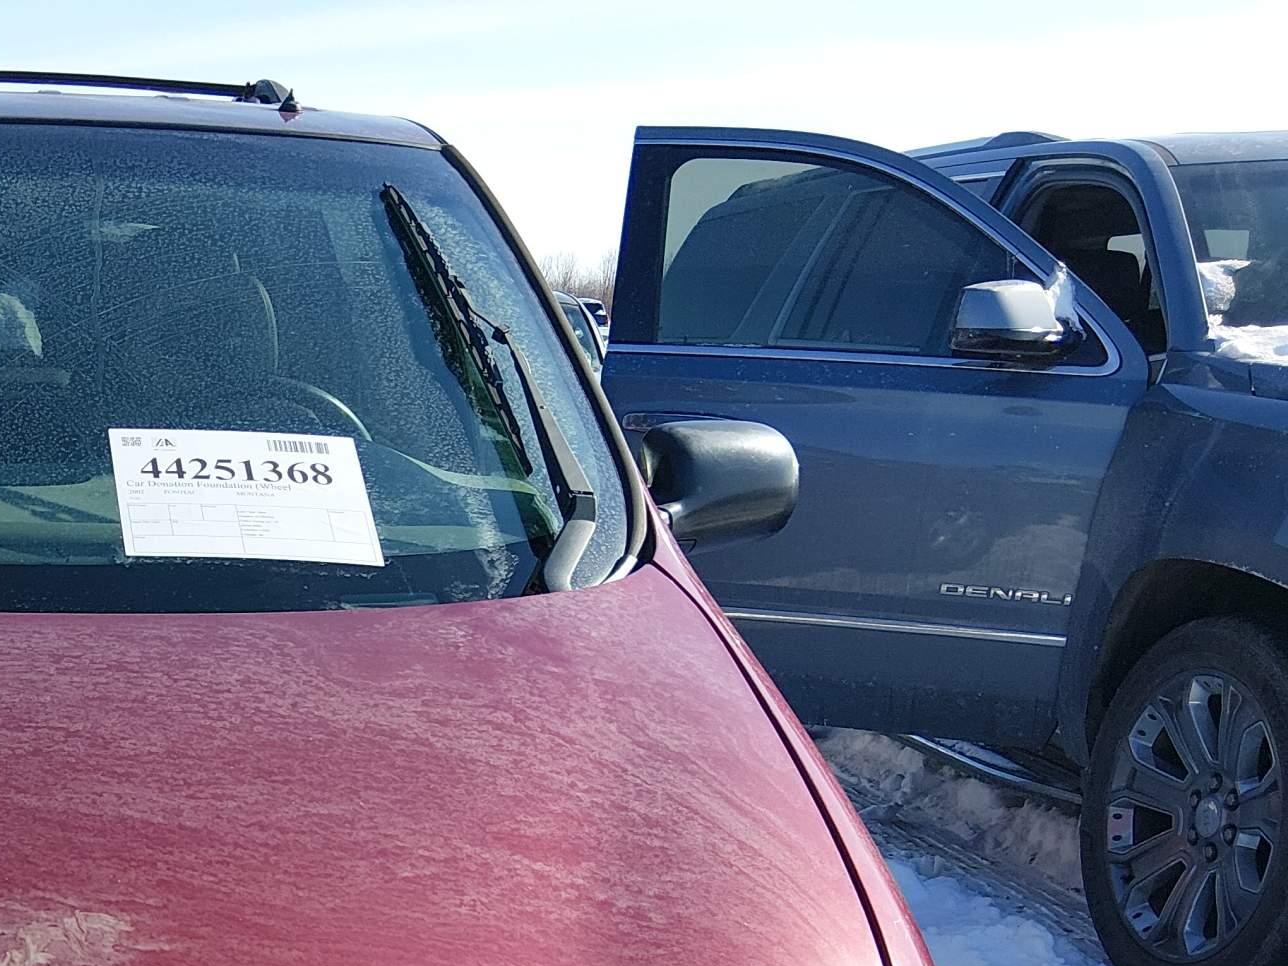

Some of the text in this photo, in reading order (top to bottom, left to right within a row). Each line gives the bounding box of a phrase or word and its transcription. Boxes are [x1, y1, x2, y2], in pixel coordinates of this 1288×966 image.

[140, 456, 334, 486] 44251368
[126, 480, 145, 488] Car
[147, 480, 194, 488] Donation
[197, 481, 253, 489] Foundation
[939, 582, 1073, 606] DENALI
